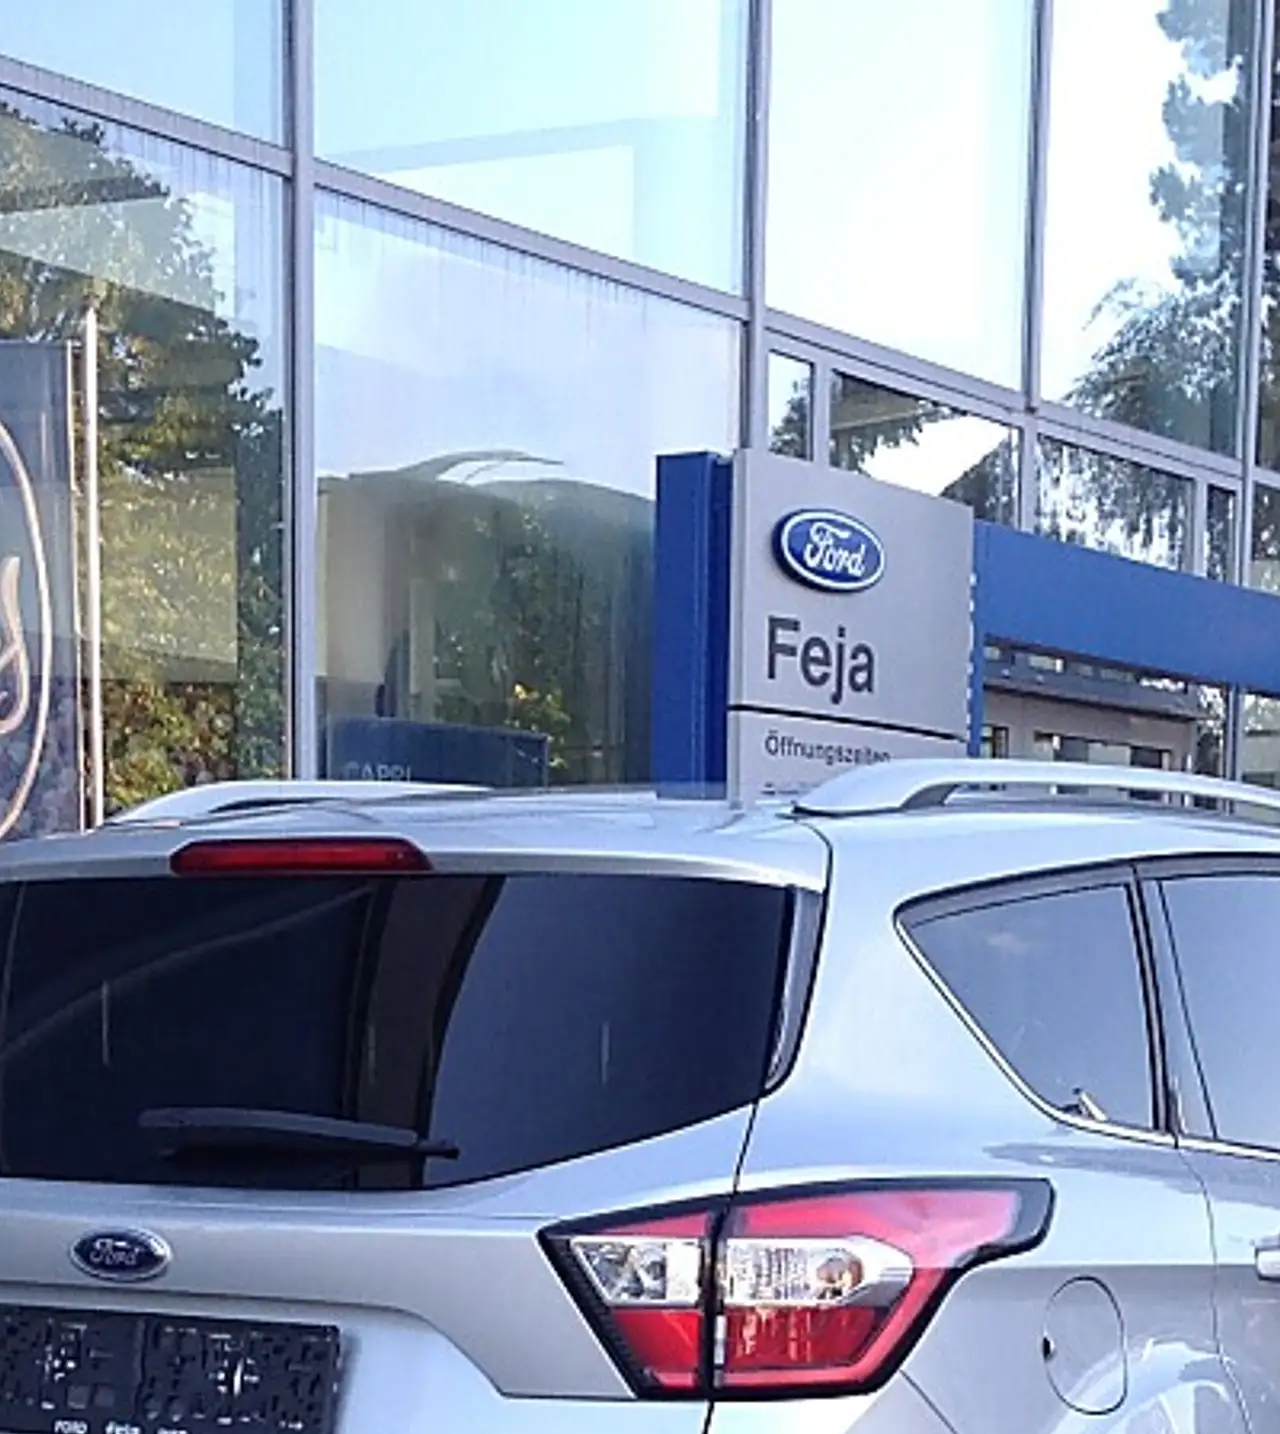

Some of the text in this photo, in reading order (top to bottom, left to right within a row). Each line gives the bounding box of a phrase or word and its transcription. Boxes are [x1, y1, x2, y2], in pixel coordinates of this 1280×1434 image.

[802, 521, 868, 577] Ford
[766, 614, 876, 704] Feja
[89, 1238, 141, 1266] Ford
